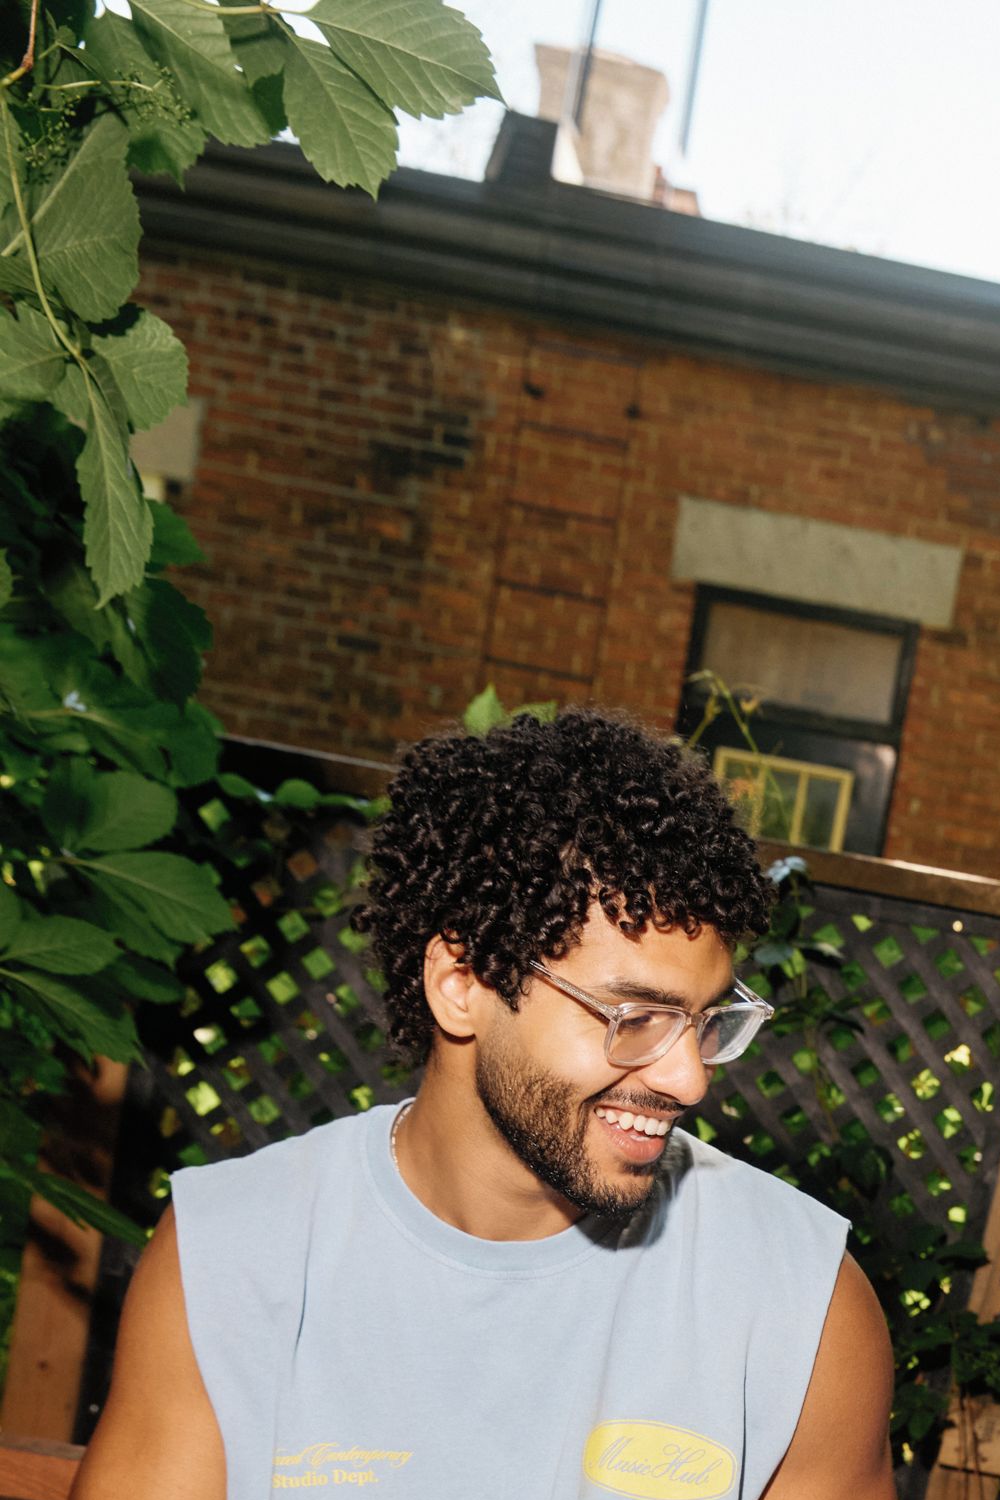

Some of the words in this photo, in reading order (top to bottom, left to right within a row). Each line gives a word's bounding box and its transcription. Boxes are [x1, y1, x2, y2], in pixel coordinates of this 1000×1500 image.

[272, 1471, 329, 1488] Studio
[332, 1468, 380, 1487] Dept.
[589, 1436, 650, 1475] Music
[651, 1443, 723, 1486] Hub
